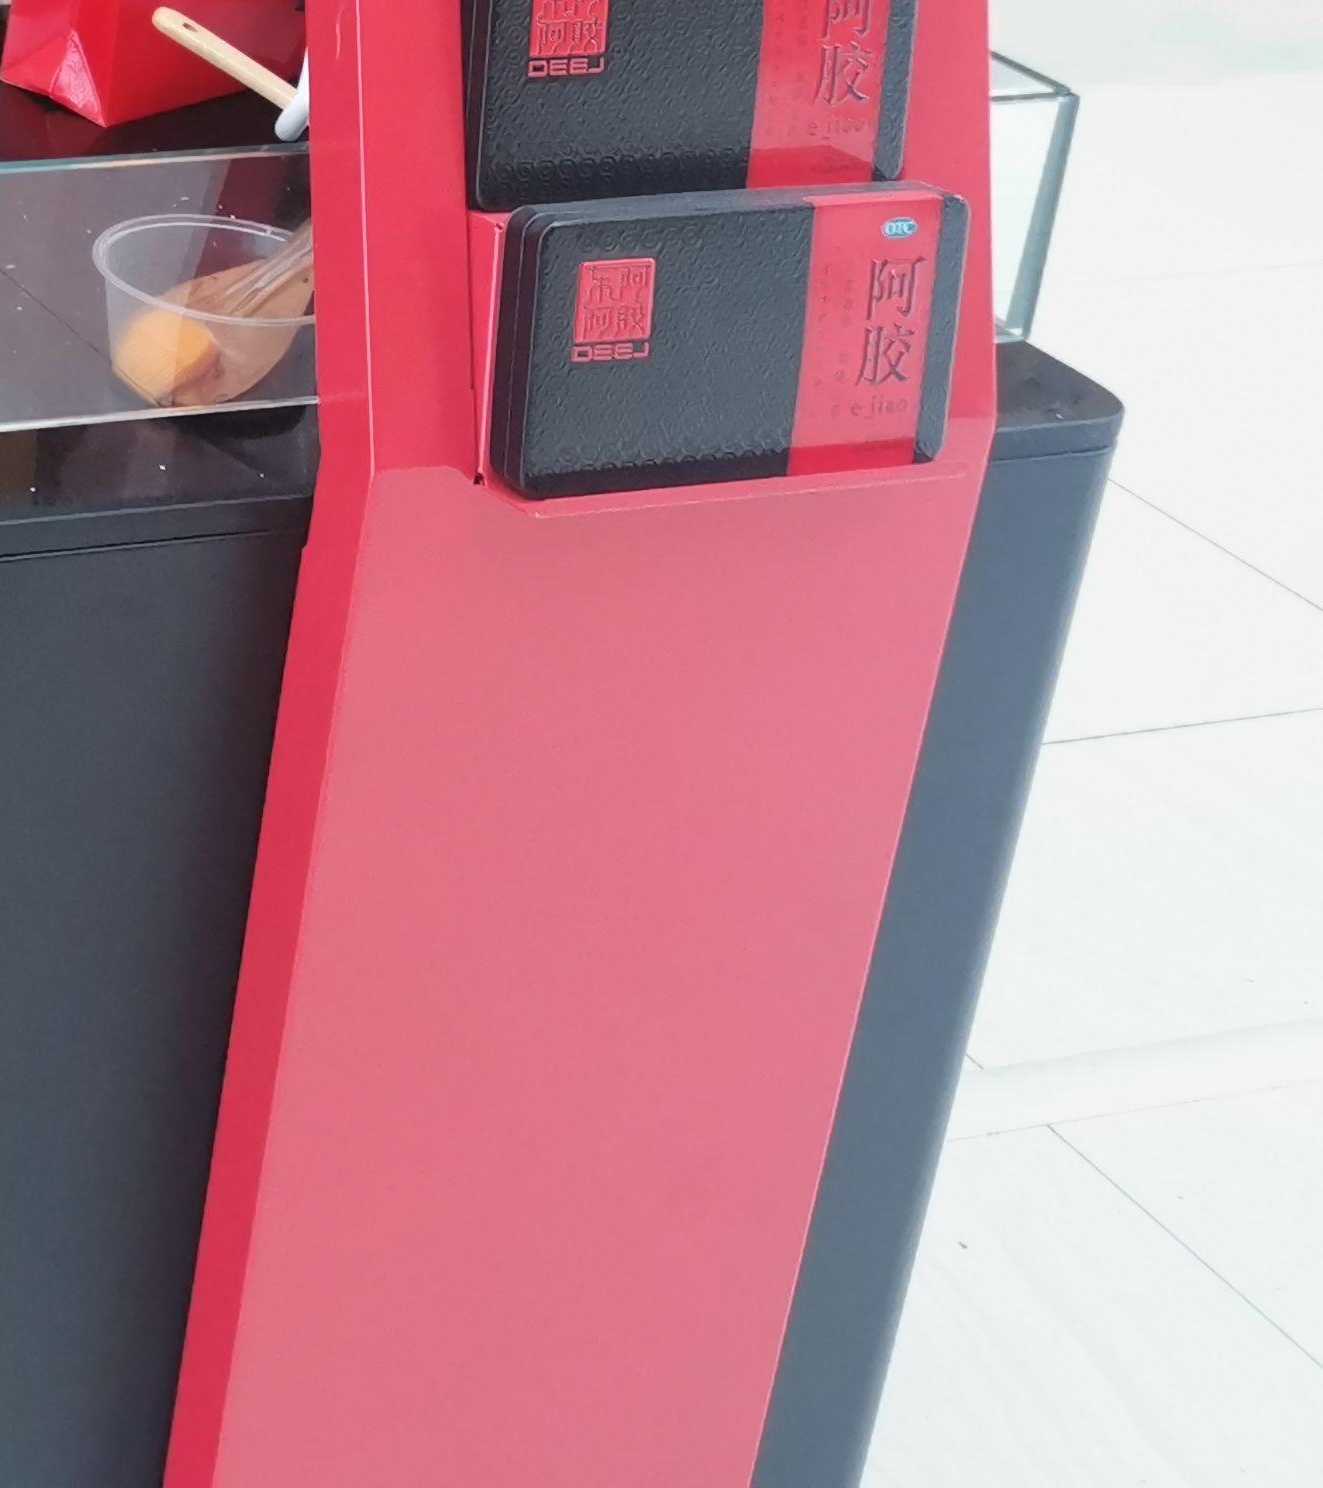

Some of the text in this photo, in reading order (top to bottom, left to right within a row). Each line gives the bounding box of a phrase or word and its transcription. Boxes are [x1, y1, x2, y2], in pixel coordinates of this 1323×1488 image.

[528, 57, 604, 77] DEEJ
[884, 222, 915, 235] OTC
[855, 256, 927, 386] 阿胶
[571, 342, 649, 362] DEEJ
